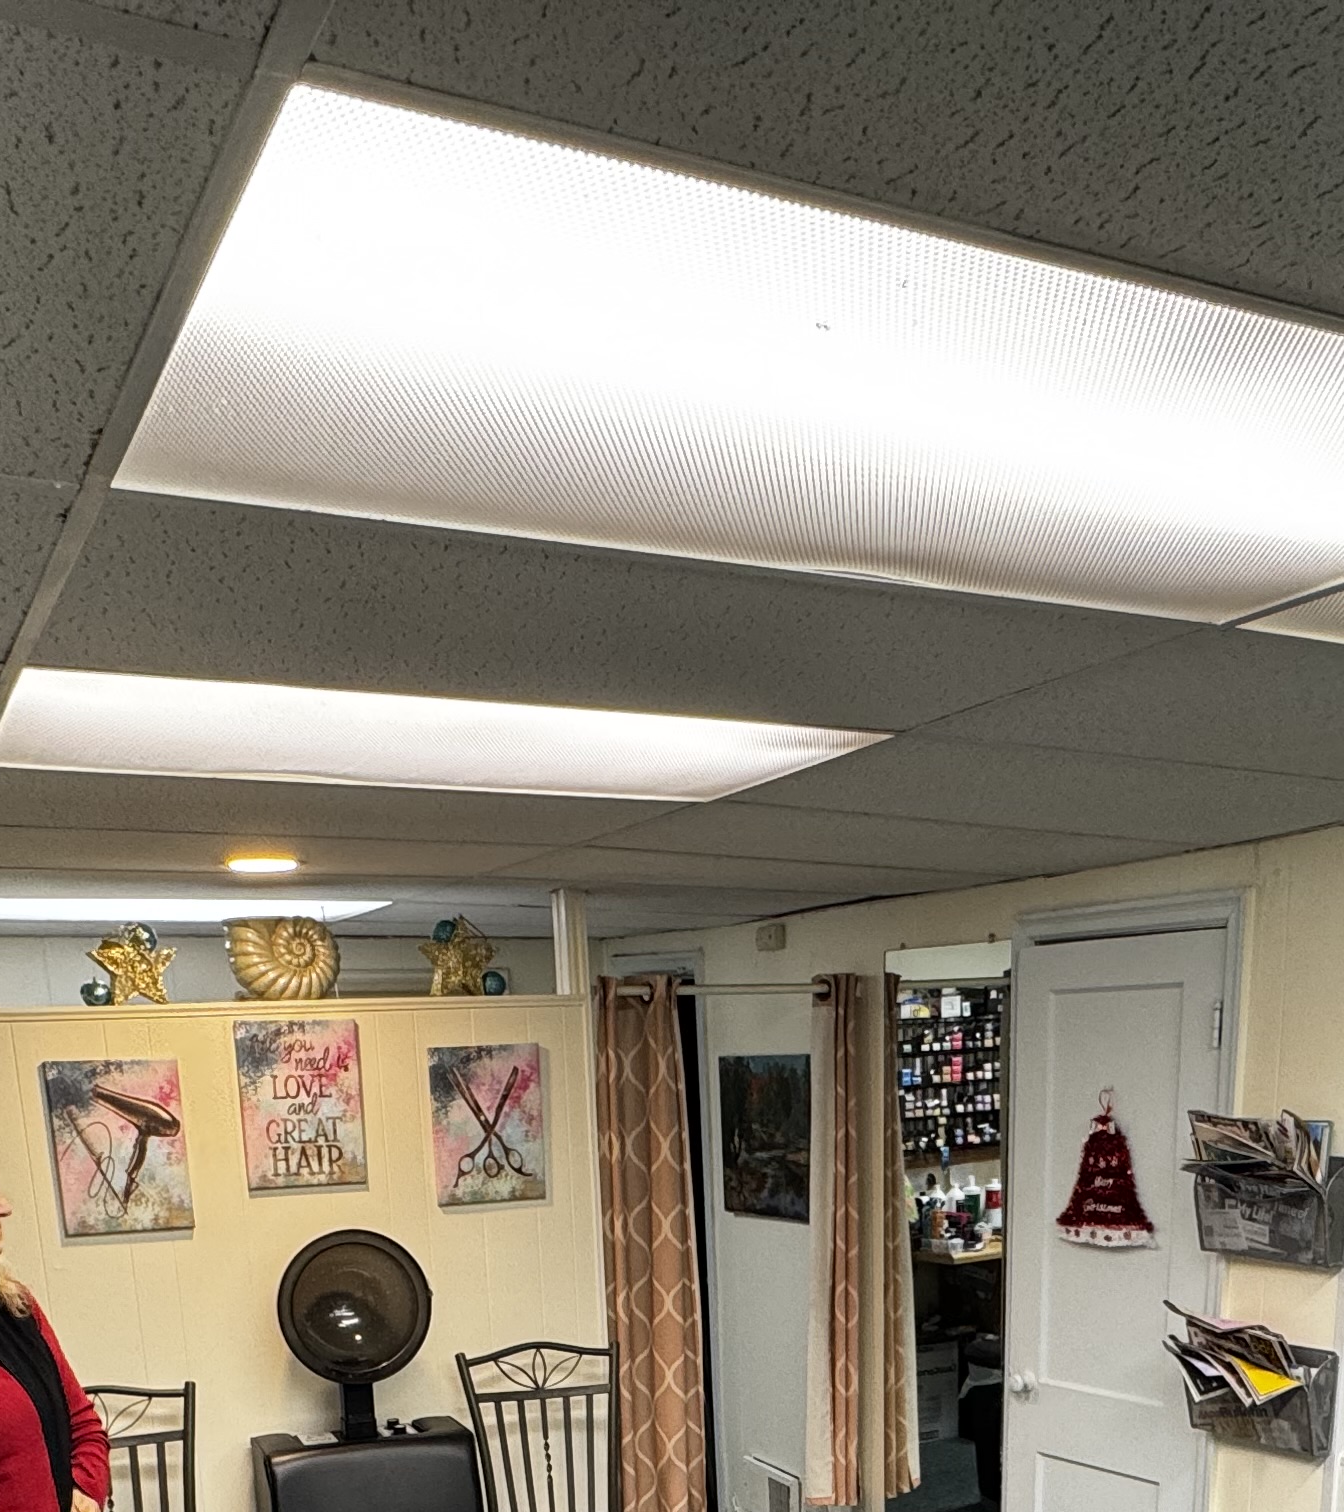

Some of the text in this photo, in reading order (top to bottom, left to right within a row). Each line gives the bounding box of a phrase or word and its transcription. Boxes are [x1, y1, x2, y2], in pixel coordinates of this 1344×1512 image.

[281, 1039, 315, 1063] you
[295, 1047, 332, 1072] need
[271, 1074, 332, 1100] LOVE
[287, 1092, 319, 1116] and
[265, 1117, 343, 1145] GREAT
[269, 1144, 345, 1177] HAIR
